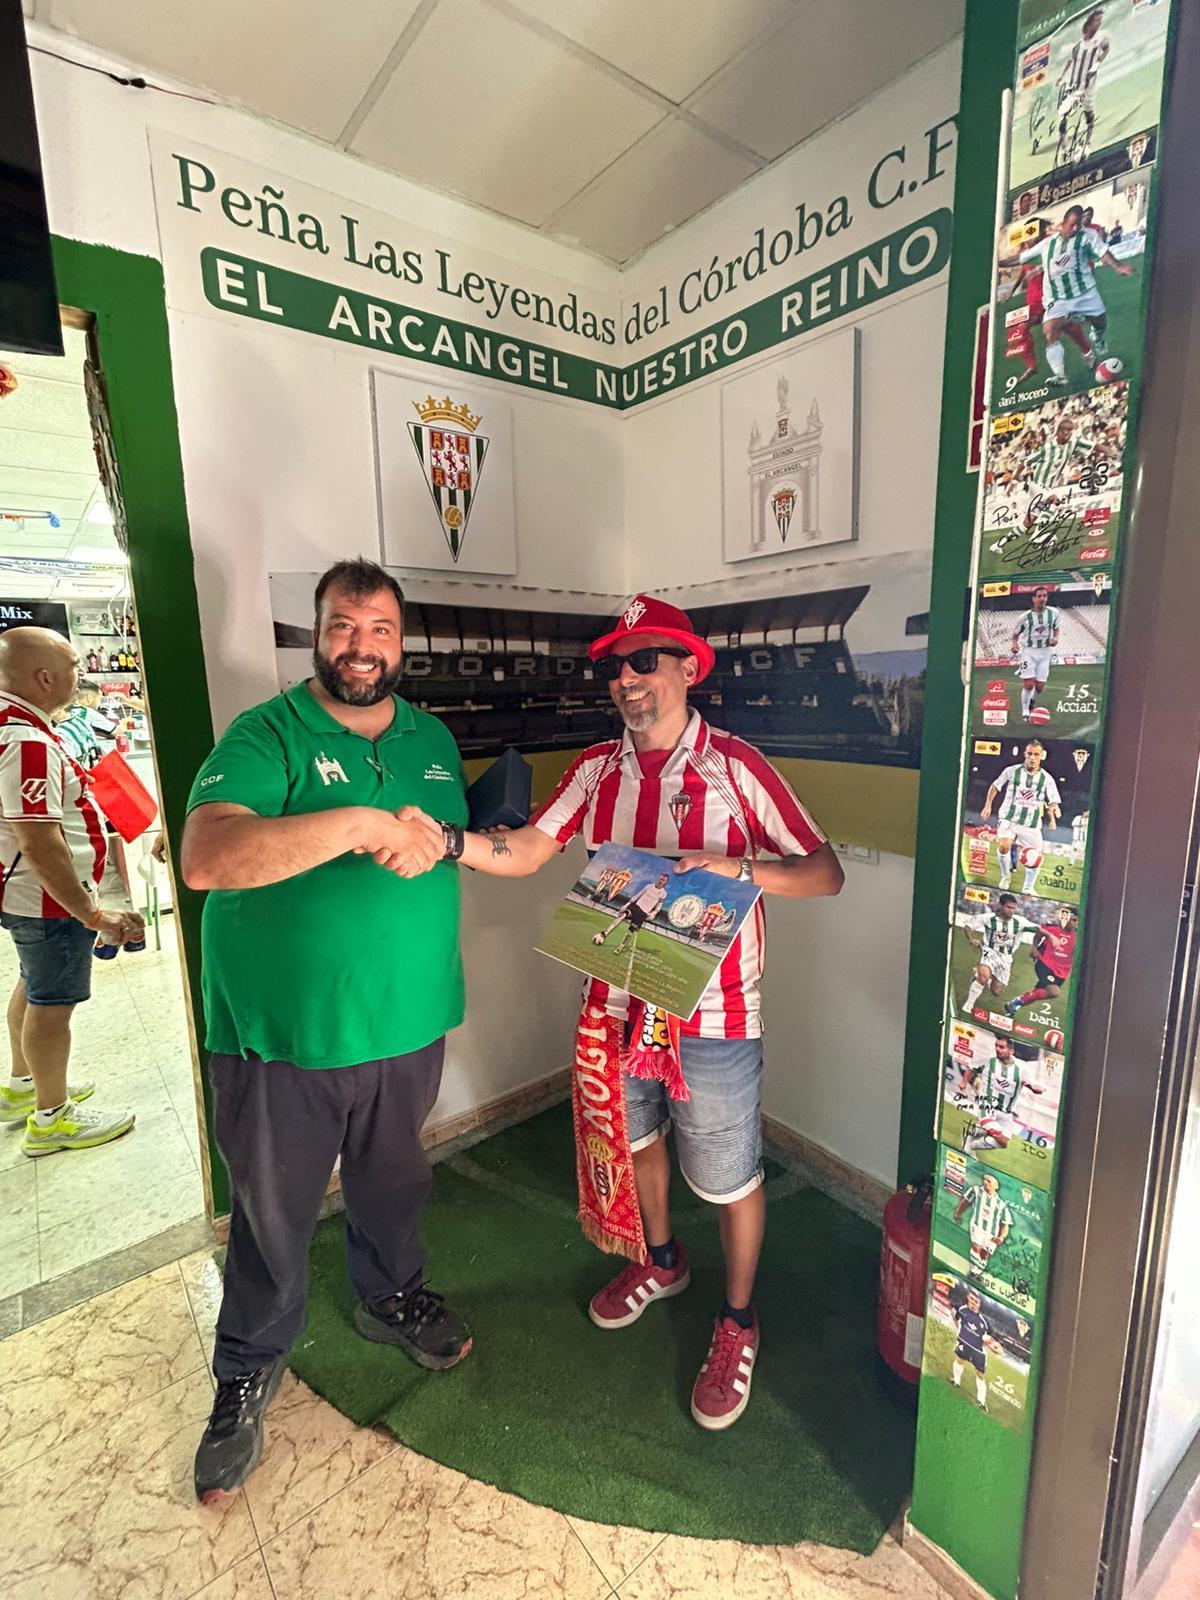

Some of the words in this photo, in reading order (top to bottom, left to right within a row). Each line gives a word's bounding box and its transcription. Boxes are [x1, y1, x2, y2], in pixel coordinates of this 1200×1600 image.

[171, 153, 330, 254] Peña
[340, 214, 424, 286] Las
[434, 248, 617, 345] Leyendas
[624, 286, 671, 345] del
[678, 195, 853, 315] Córdoba
[215, 257, 284, 316] EL
[328, 295, 569, 390] ARCANGEL
[595, 319, 748, 403] NUESTRO
[780, 225, 939, 333] REINO
[1005, 376, 1018, 394] 9
[0, 606, 33, 620] Mix
[1066, 684, 1090, 698] 15
[1056, 698, 1099, 713] Acciari
[1053, 865, 1065, 878] 8
[1039, 876, 1077, 891] Juanlu
[1040, 1002, 1052, 1015] 2
[1029, 1011, 1061, 1030] Dani
[1023, 1130, 1048, 1148] 16
[993, 1375, 1015, 1395] 26
